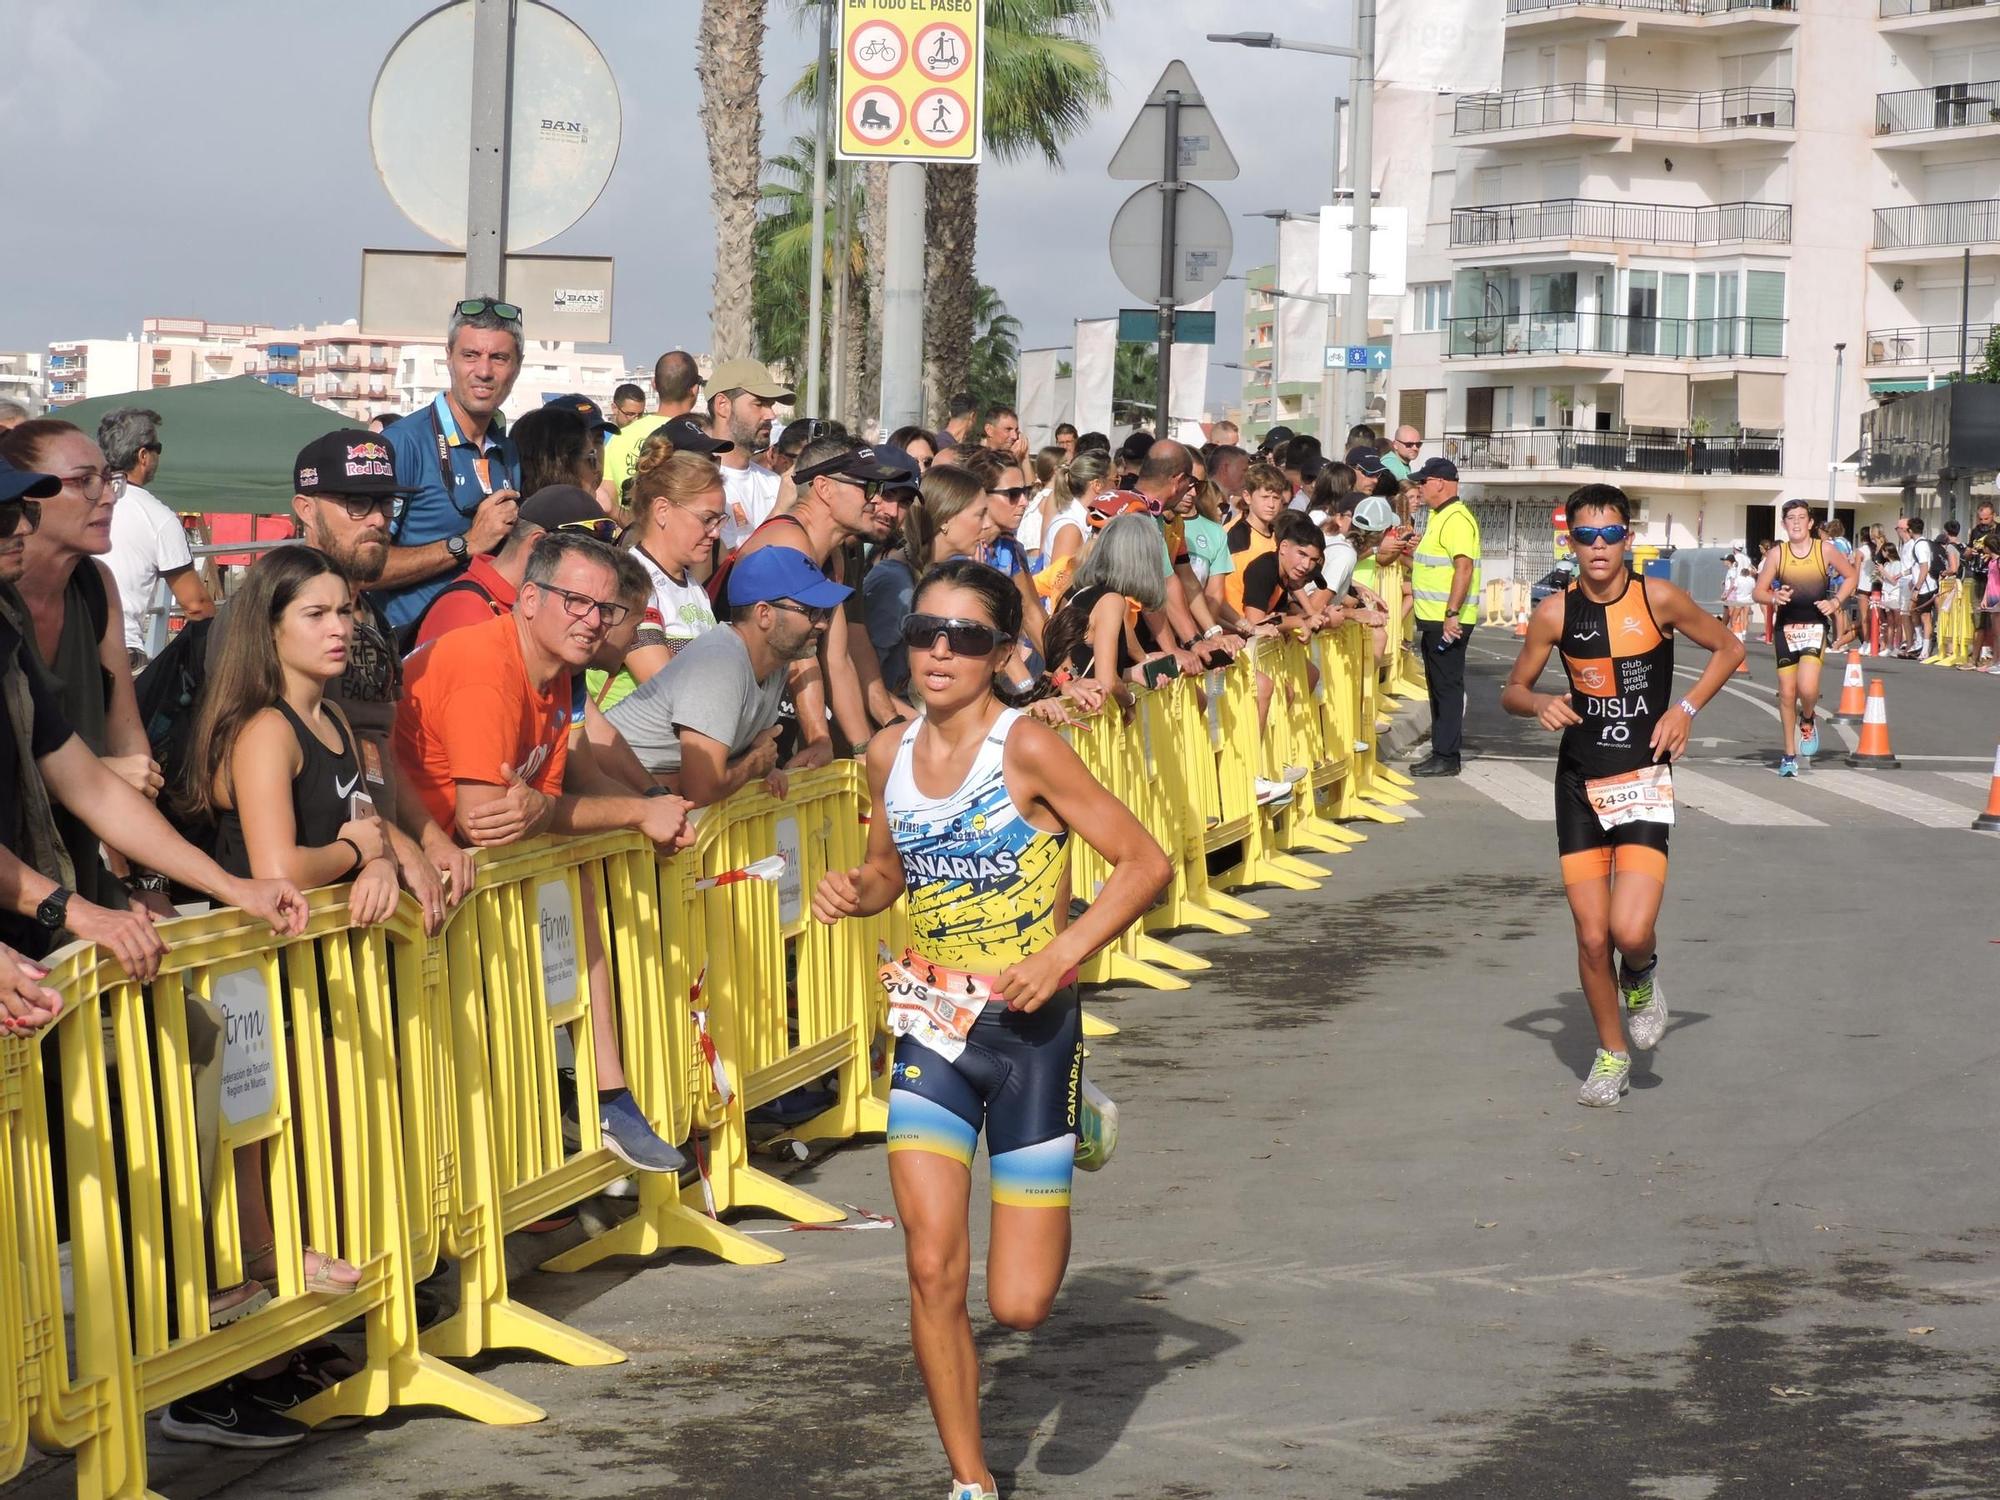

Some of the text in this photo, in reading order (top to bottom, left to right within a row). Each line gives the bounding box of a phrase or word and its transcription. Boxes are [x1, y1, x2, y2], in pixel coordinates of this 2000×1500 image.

[849, 0, 972, 12] EN TODO EL PASEO
[541, 119, 581, 132] BAN
[437, 433, 449, 460] PENTAX
[345, 460, 394, 476] Red Bull
[1786, 632, 1807, 641] 2440
[1621, 659, 1642, 670] club
[1624, 681, 1649, 694] yecla
[1587, 695, 1649, 718] DISLA
[1595, 790, 1638, 809] 2430
[904, 850, 1017, 879] ANARIAS
[1067, 1041, 1083, 1127] CANARIAS
